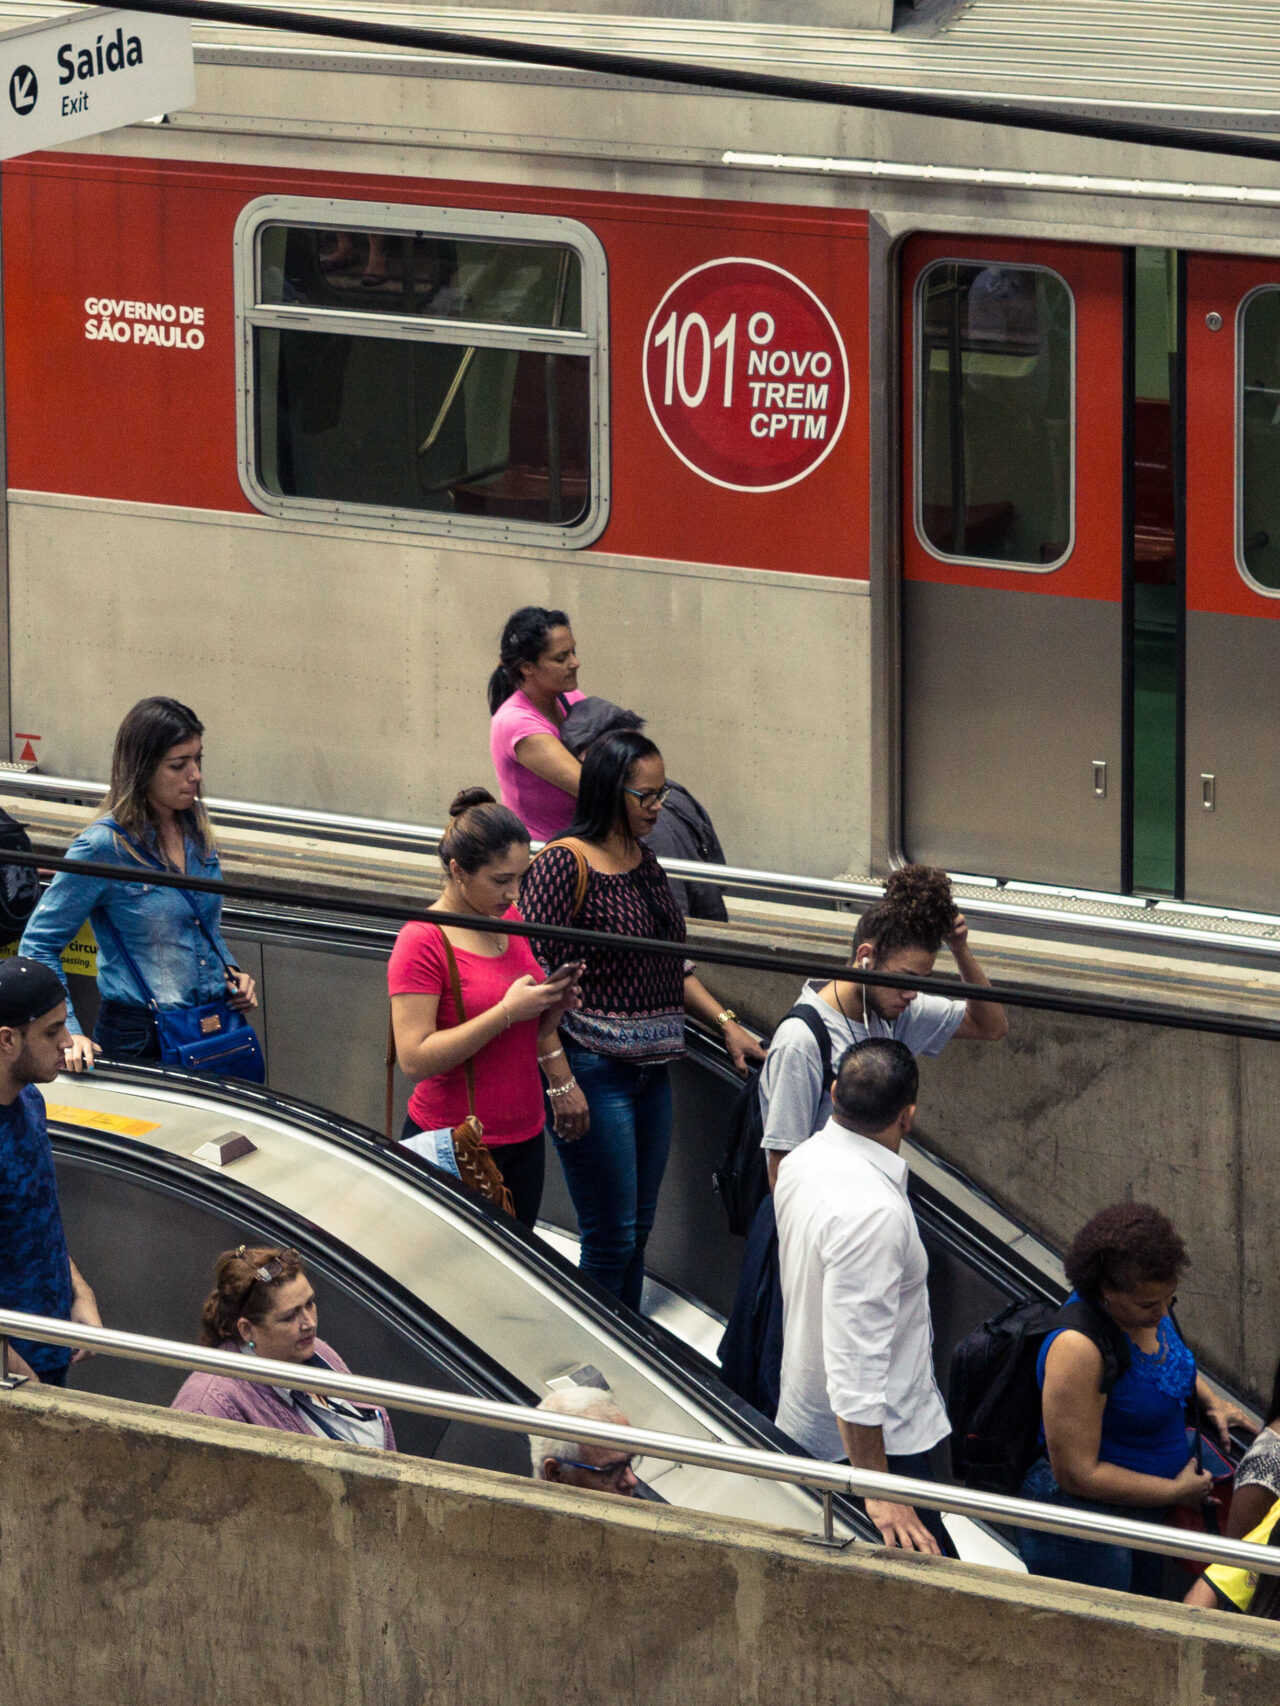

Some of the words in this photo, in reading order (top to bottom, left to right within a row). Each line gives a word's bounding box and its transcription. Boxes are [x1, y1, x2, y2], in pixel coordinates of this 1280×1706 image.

[57, 27, 143, 85] Saída
[61, 91, 89, 116] Exit
[84, 297, 177, 322] GOVERNO
[179, 305, 204, 325] DE
[84, 316, 131, 343] SÃO
[133, 322, 205, 350] PAULO
[747, 350, 832, 378] NOVO
[748, 382, 829, 409] TREM
[750, 413, 827, 439] CPTM
[69, 940, 98, 954] circu
